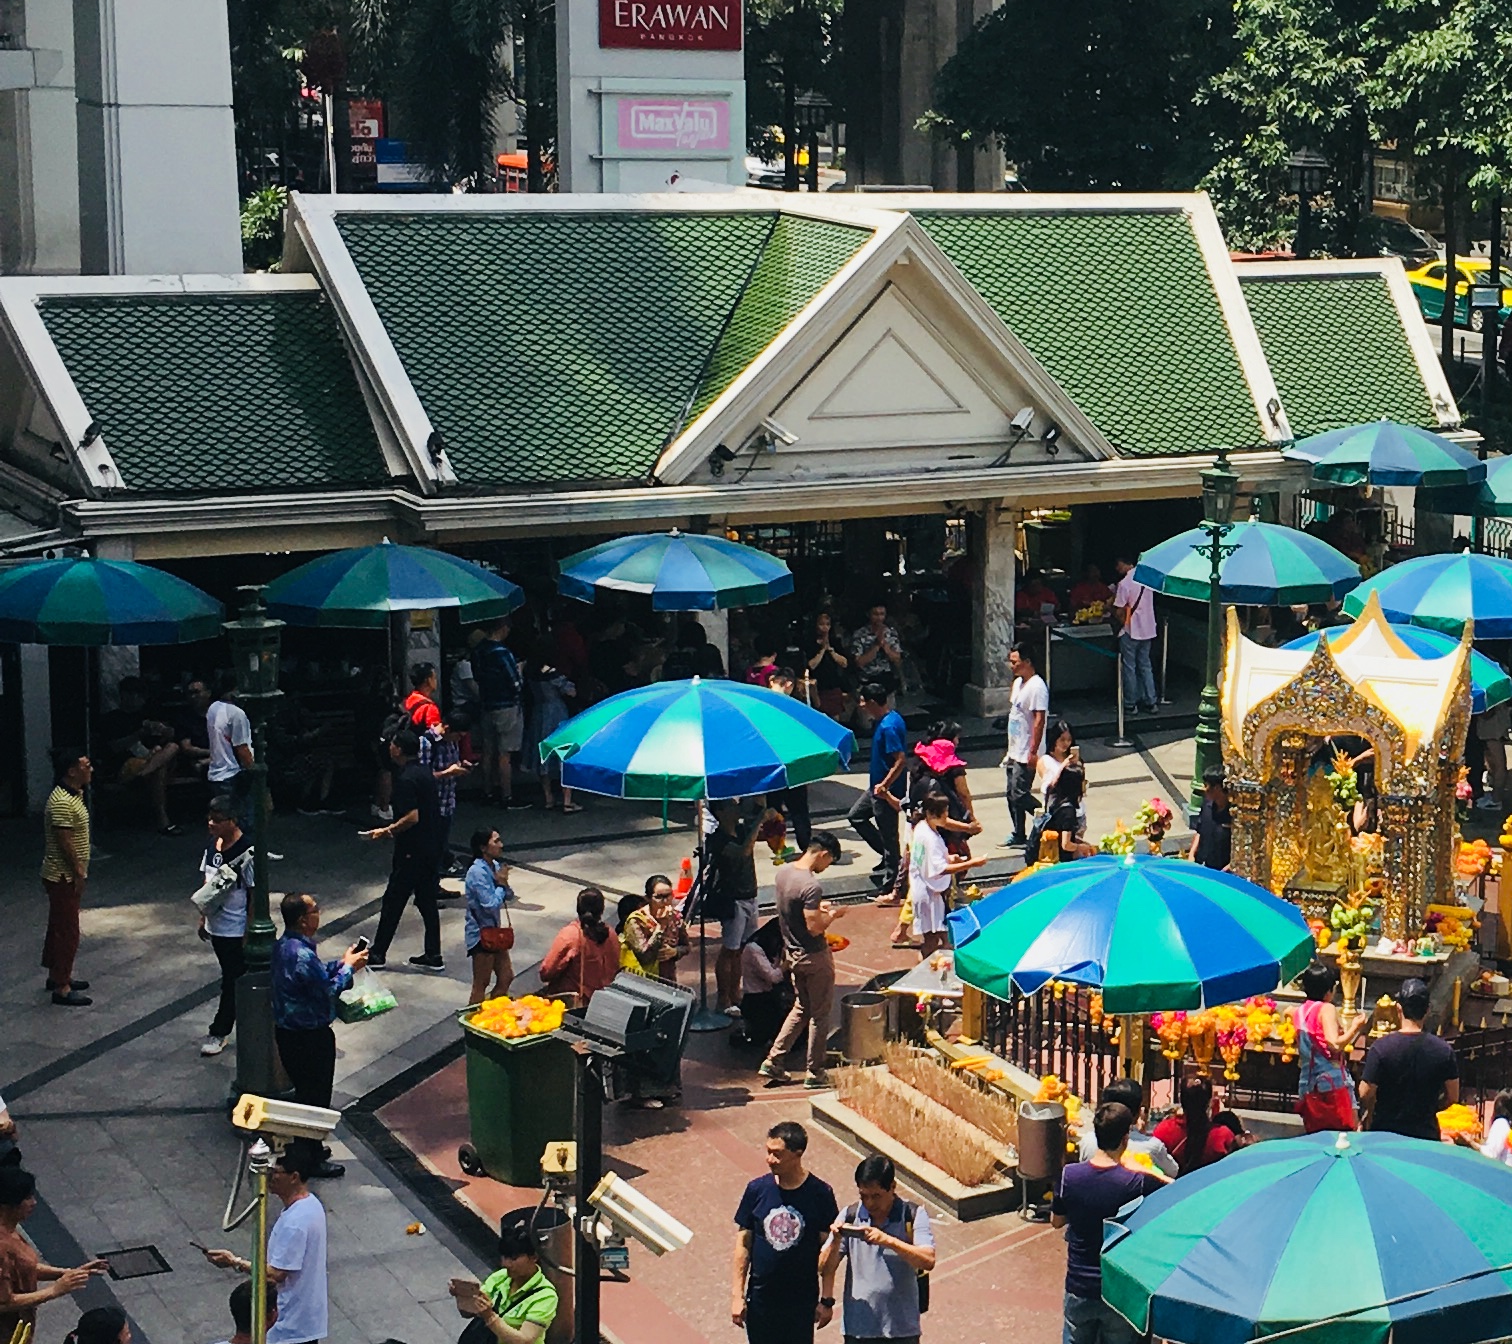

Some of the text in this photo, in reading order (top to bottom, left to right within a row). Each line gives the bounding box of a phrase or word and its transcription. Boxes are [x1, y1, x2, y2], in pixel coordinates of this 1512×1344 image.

[614, 0, 729, 31] ERAWAN
[640, 33, 704, 42] BANGKOK
[639, 102, 710, 132] MaxValu
